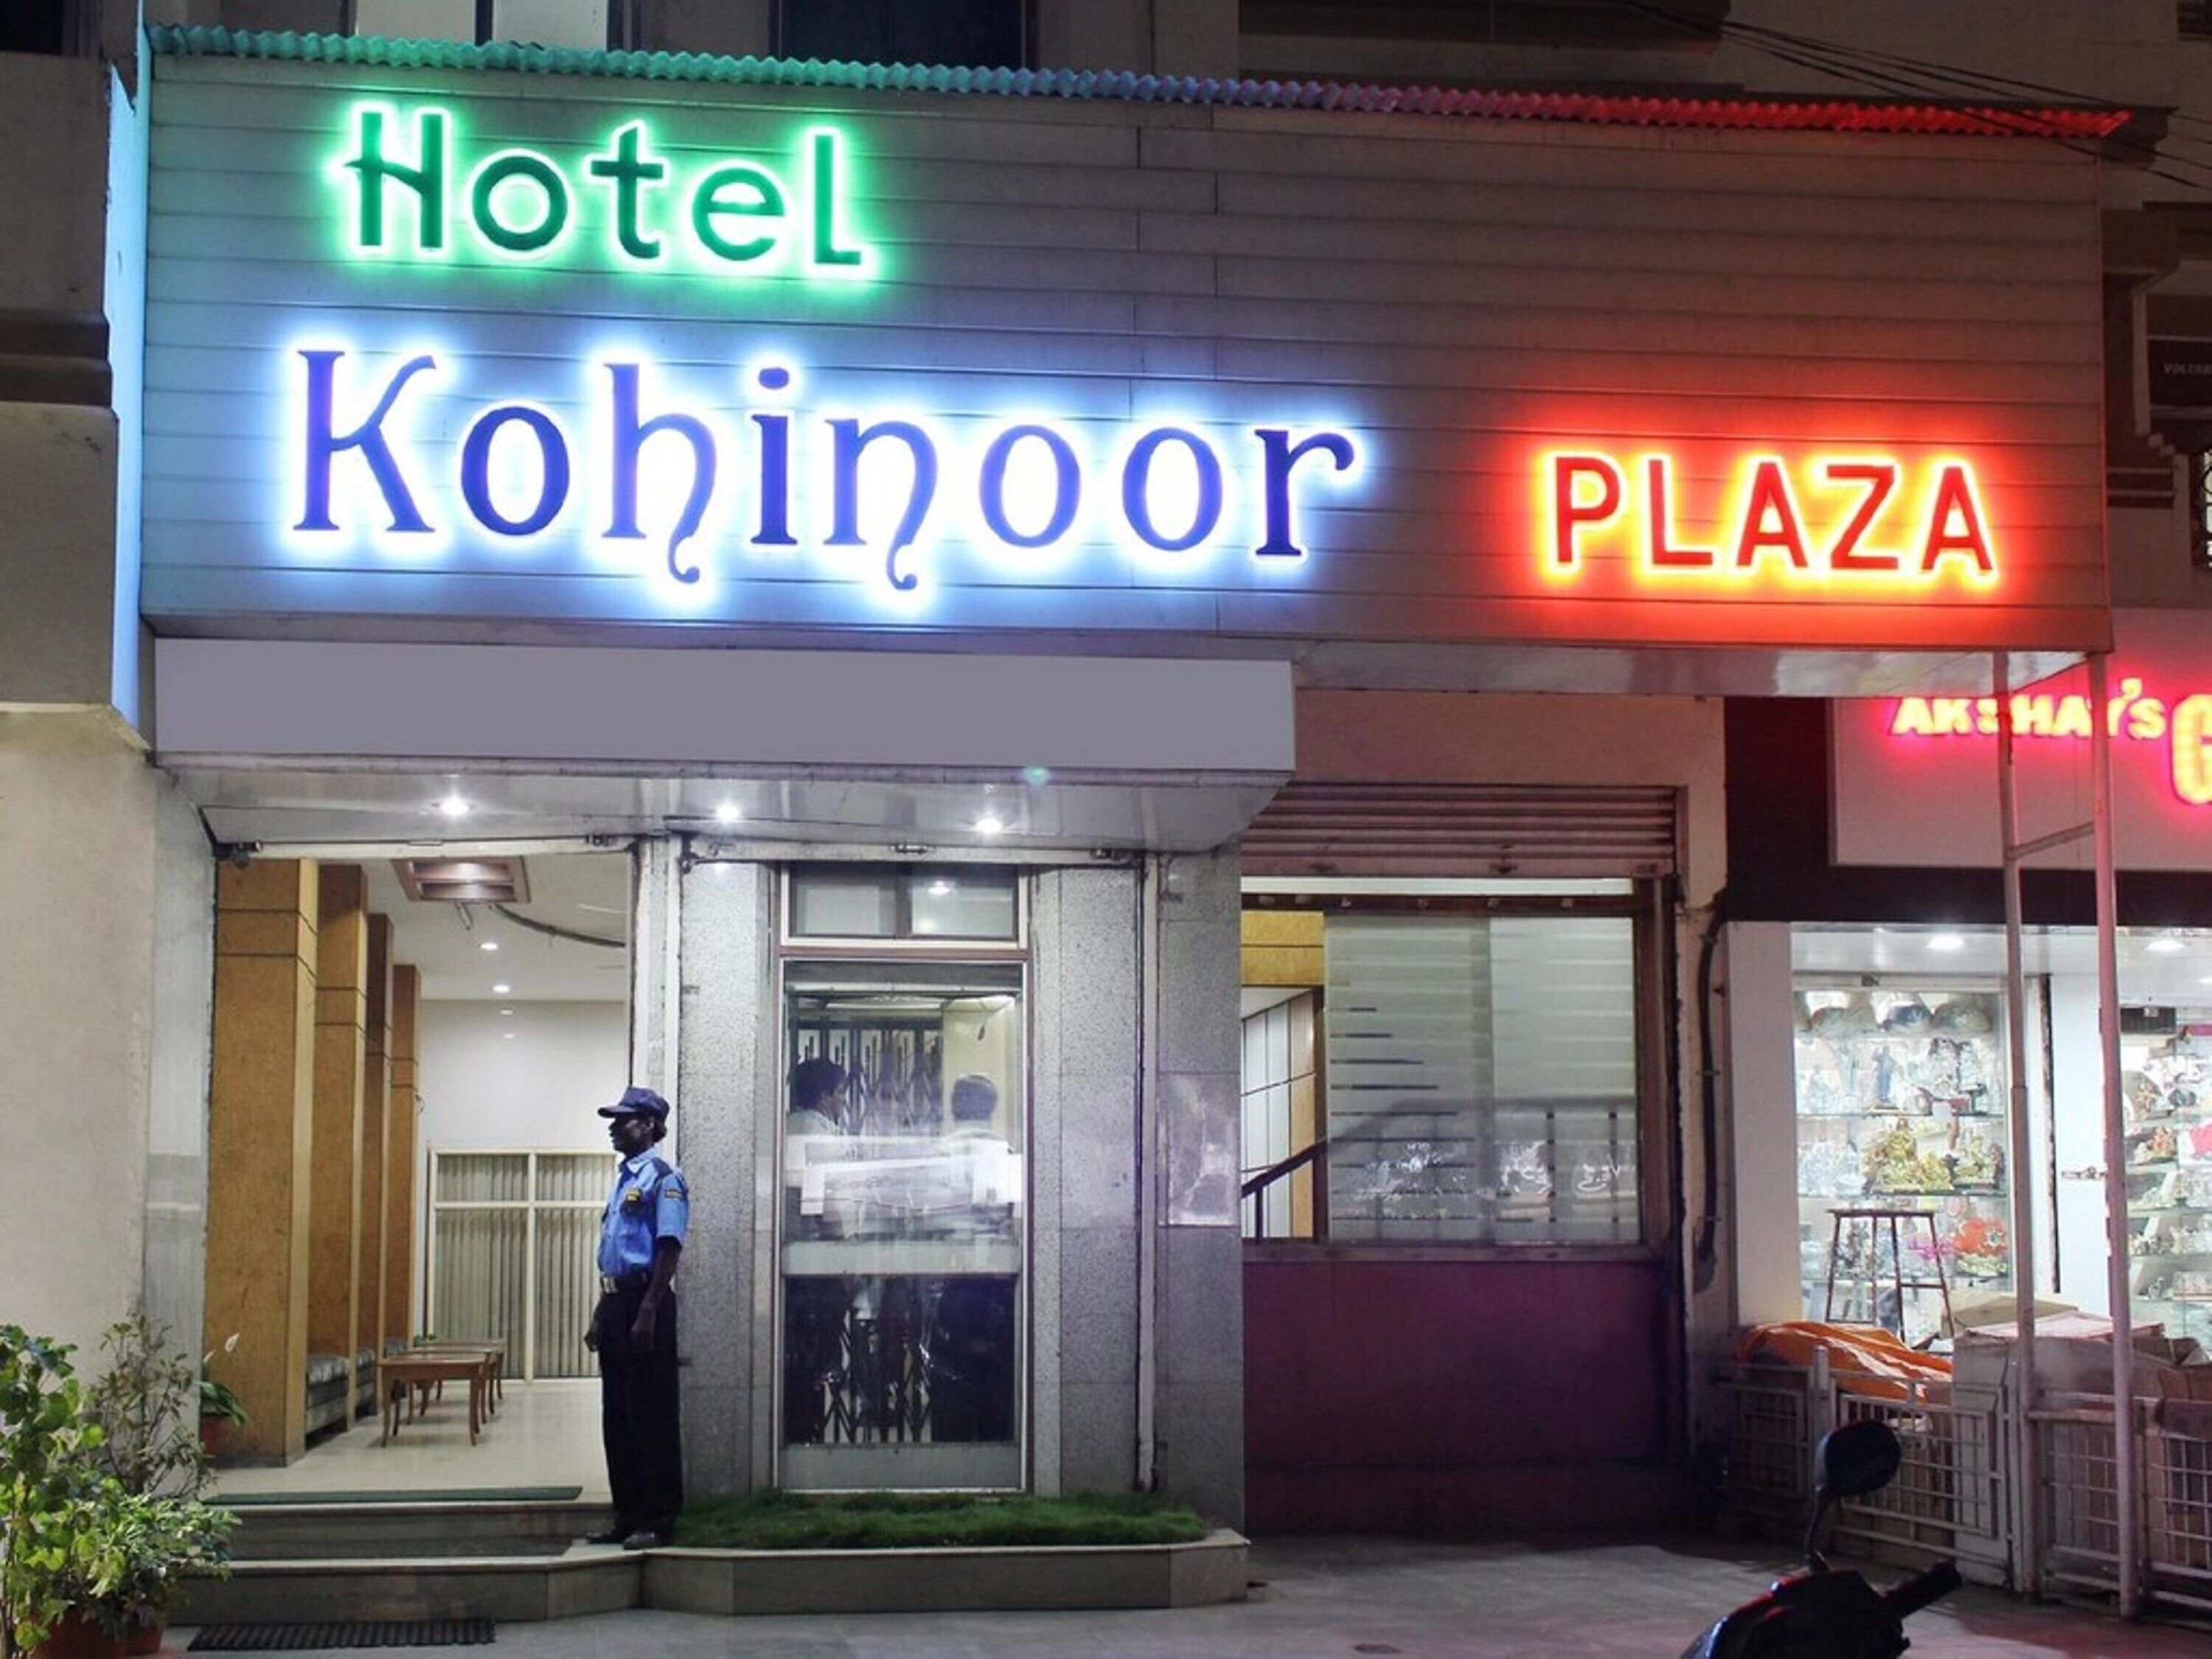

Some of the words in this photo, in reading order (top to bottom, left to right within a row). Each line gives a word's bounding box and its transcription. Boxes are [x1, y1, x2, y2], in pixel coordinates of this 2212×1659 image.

[343, 111, 863, 266] Hotel
[292, 349, 1355, 591] Kohinoor
[1554, 455, 1994, 572] PLAZA
